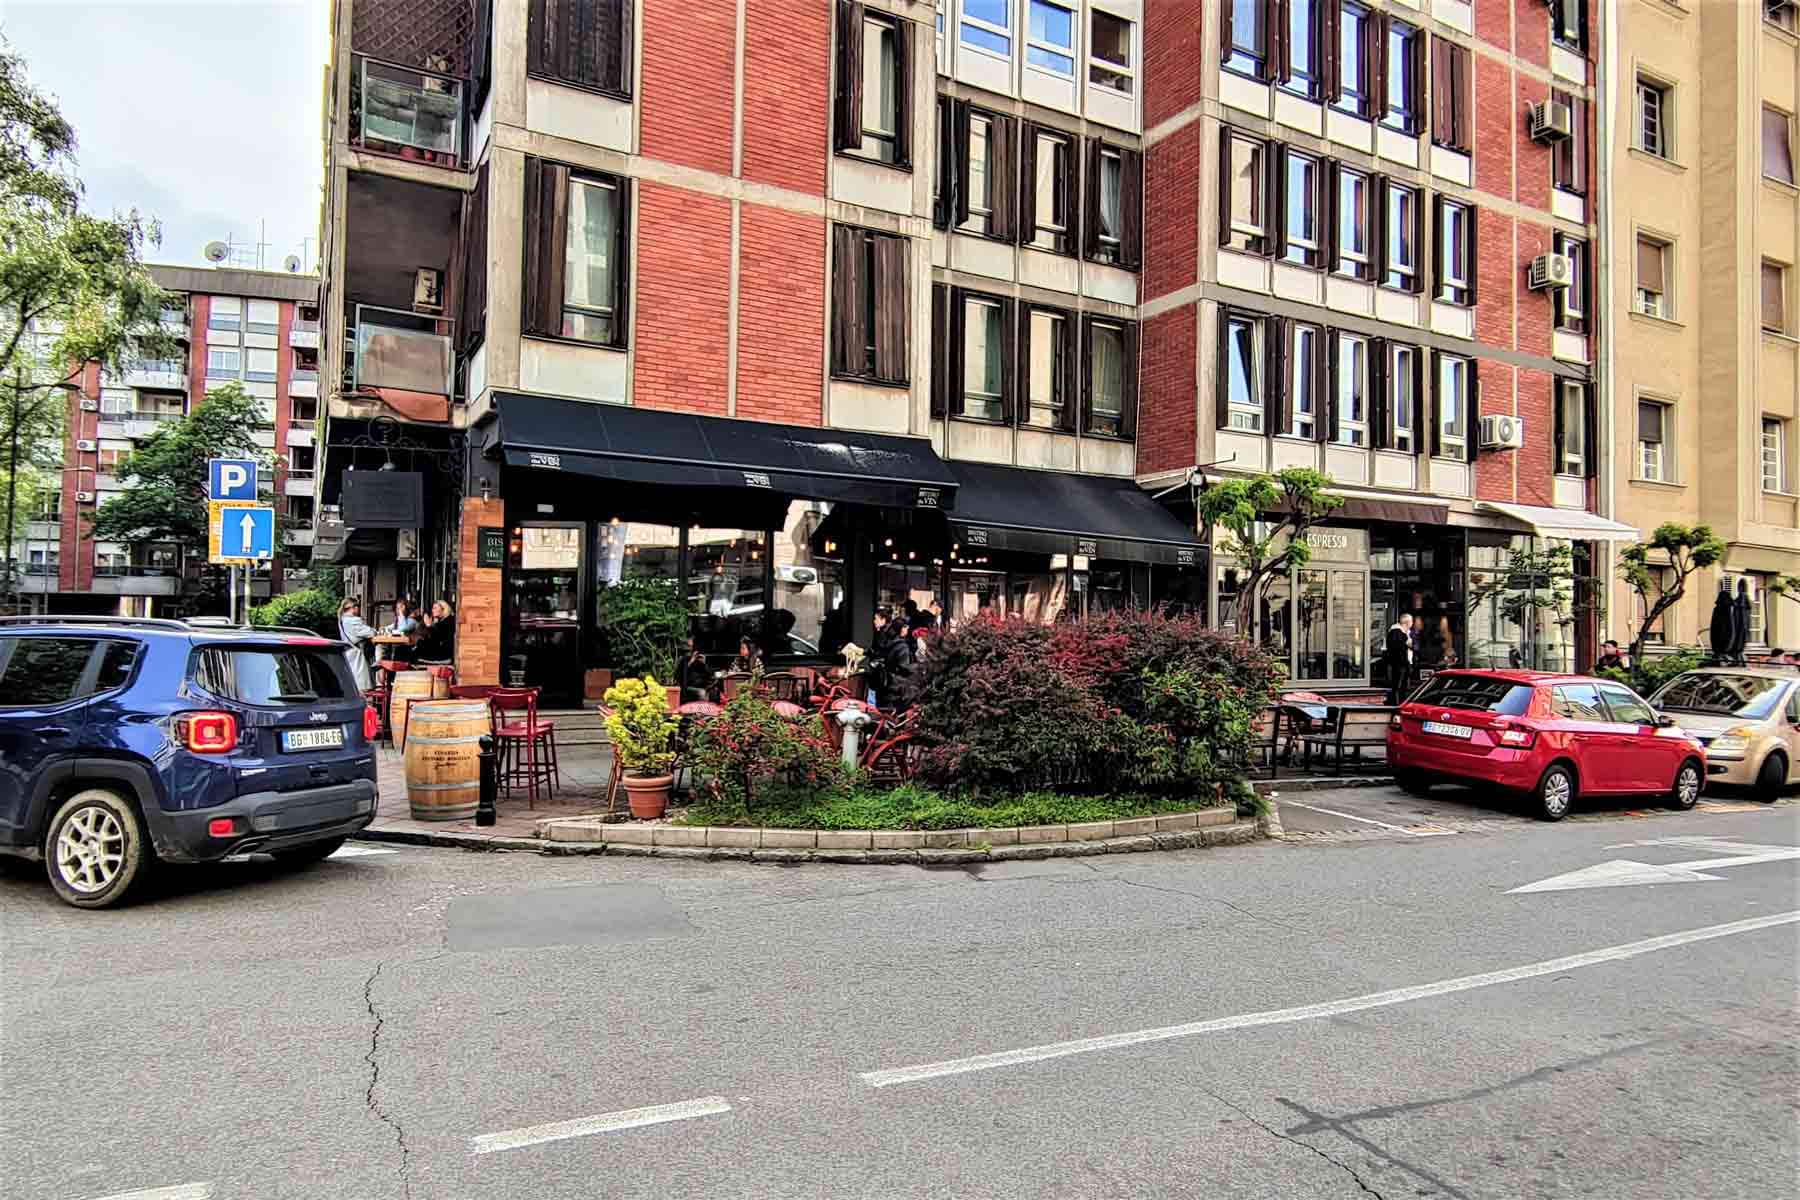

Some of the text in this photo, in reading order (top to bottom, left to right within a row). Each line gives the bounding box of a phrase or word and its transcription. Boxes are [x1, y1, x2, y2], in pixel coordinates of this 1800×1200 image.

[220, 464, 247, 496] P
[1306, 533, 1348, 549] ESPRESSO
[308, 711, 328, 722] Jeep
